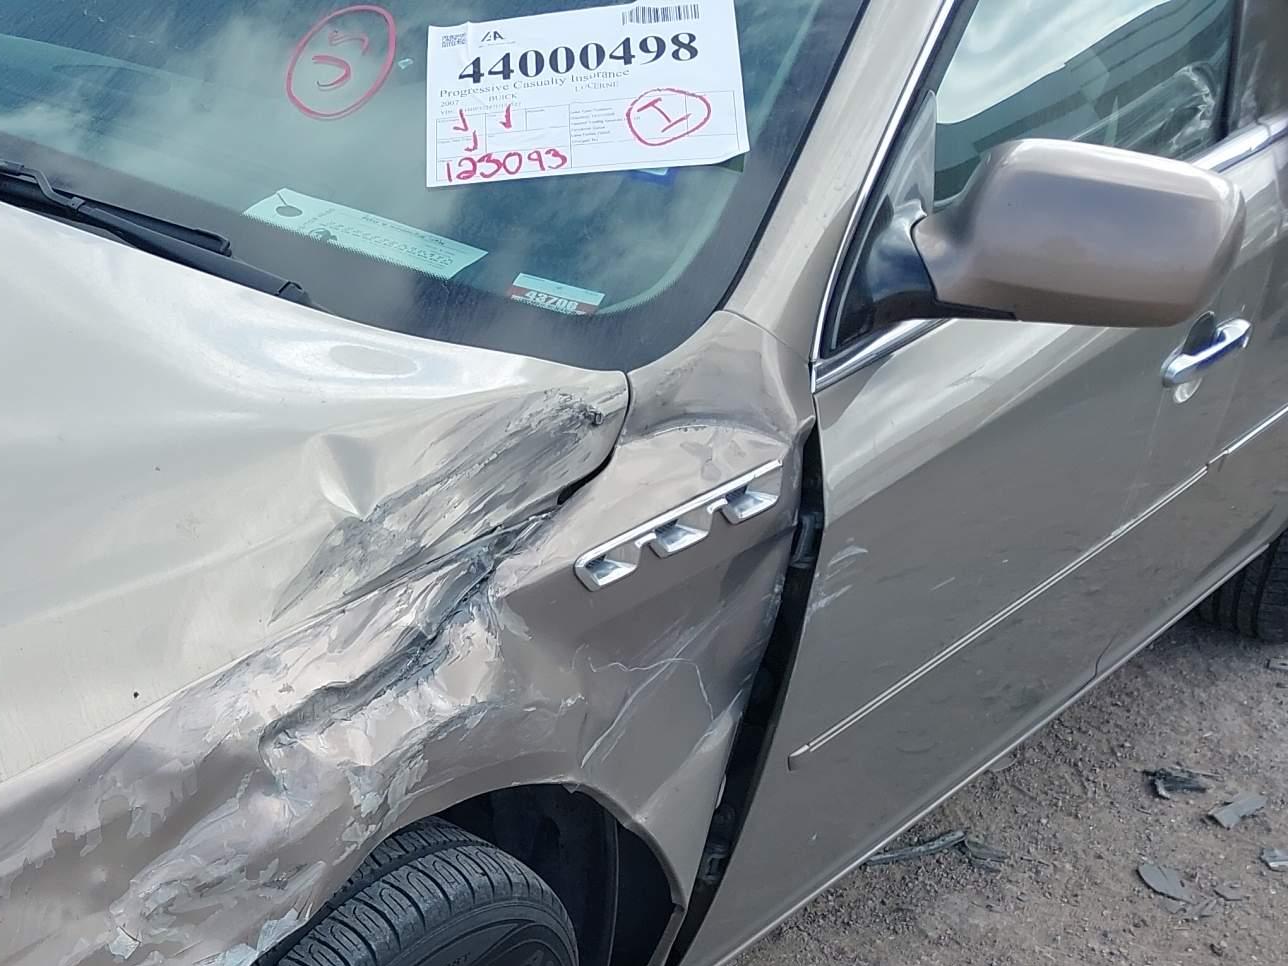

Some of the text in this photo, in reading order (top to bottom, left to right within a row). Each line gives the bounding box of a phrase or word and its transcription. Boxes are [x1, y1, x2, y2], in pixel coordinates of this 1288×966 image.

[458, 32, 699, 83] 44000498
[439, 69, 631, 98] Progressive Casualty Insurance
[488, 93, 517, 102] BUICK
[446, 148, 567, 182] 123093
